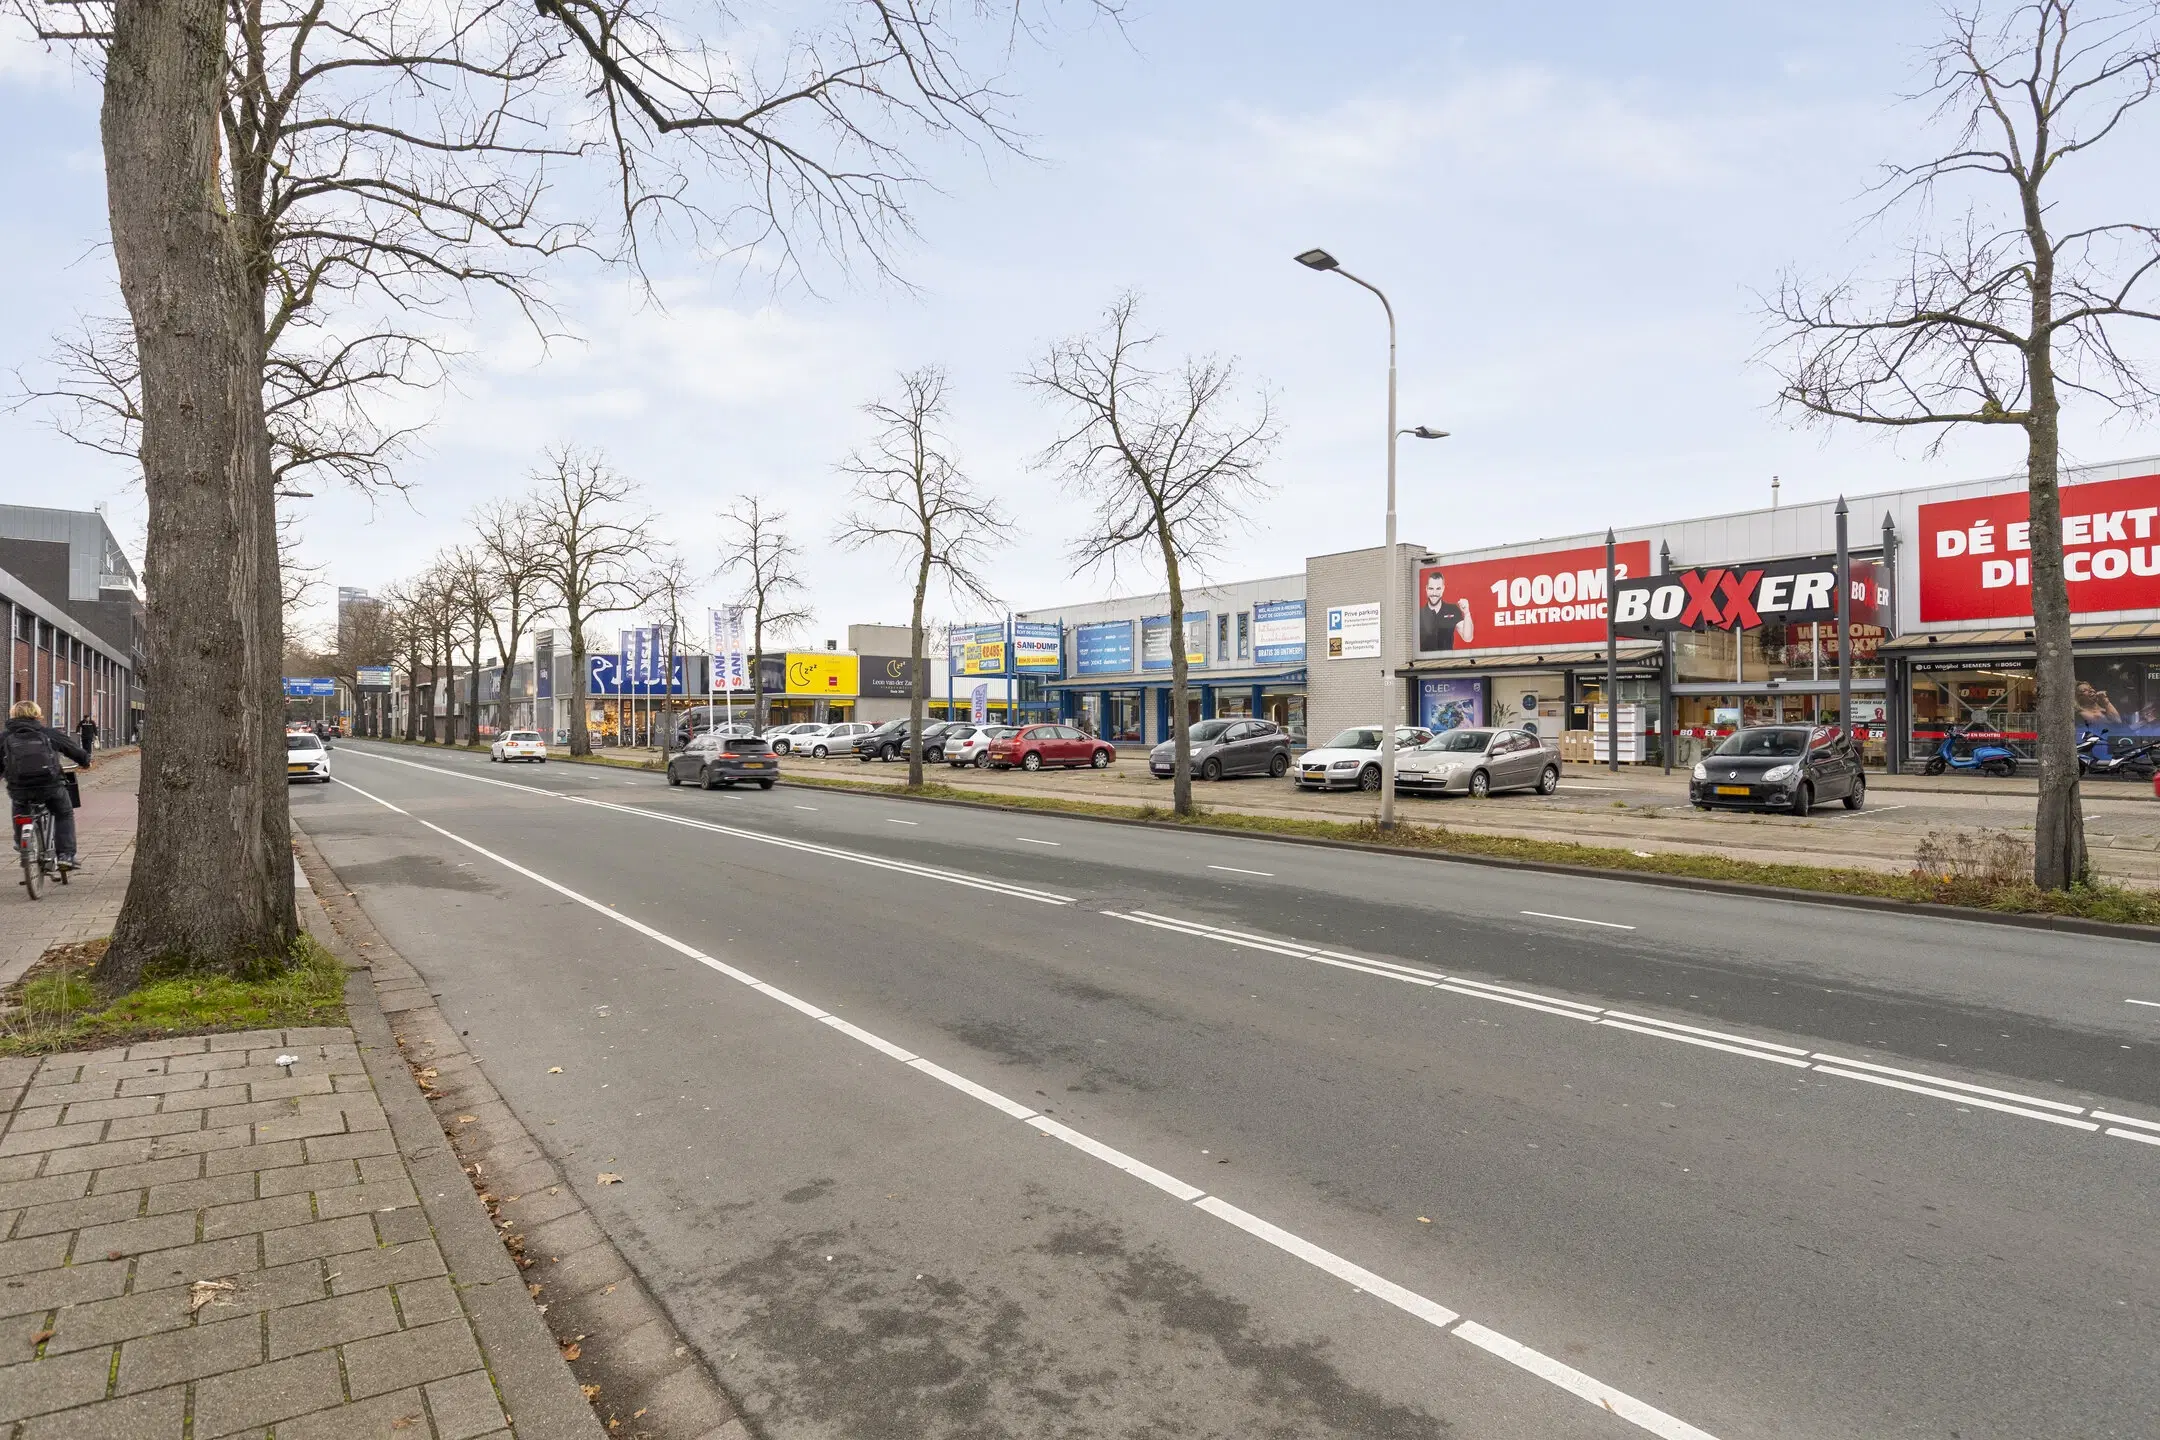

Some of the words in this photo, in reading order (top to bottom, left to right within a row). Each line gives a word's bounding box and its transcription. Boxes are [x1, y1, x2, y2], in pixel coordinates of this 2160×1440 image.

[1937, 519, 1994, 558] DÉ
[2007, 507, 2158, 551] EEKT
[1982, 545, 2160, 588] DICOU
[1614, 568, 1835, 631] BOXXER
[1494, 602, 1608, 626] ELEKTRONIC
[1797, 624, 1882, 639] WELOM
[1017, 641, 1058, 650] SANI-DUMP
[1425, 684, 1449, 692] OLED
[1960, 687, 2005, 698] OXXER
[1680, 728, 1716, 739] BOXXER
[1850, 728, 1884, 740] XXER
